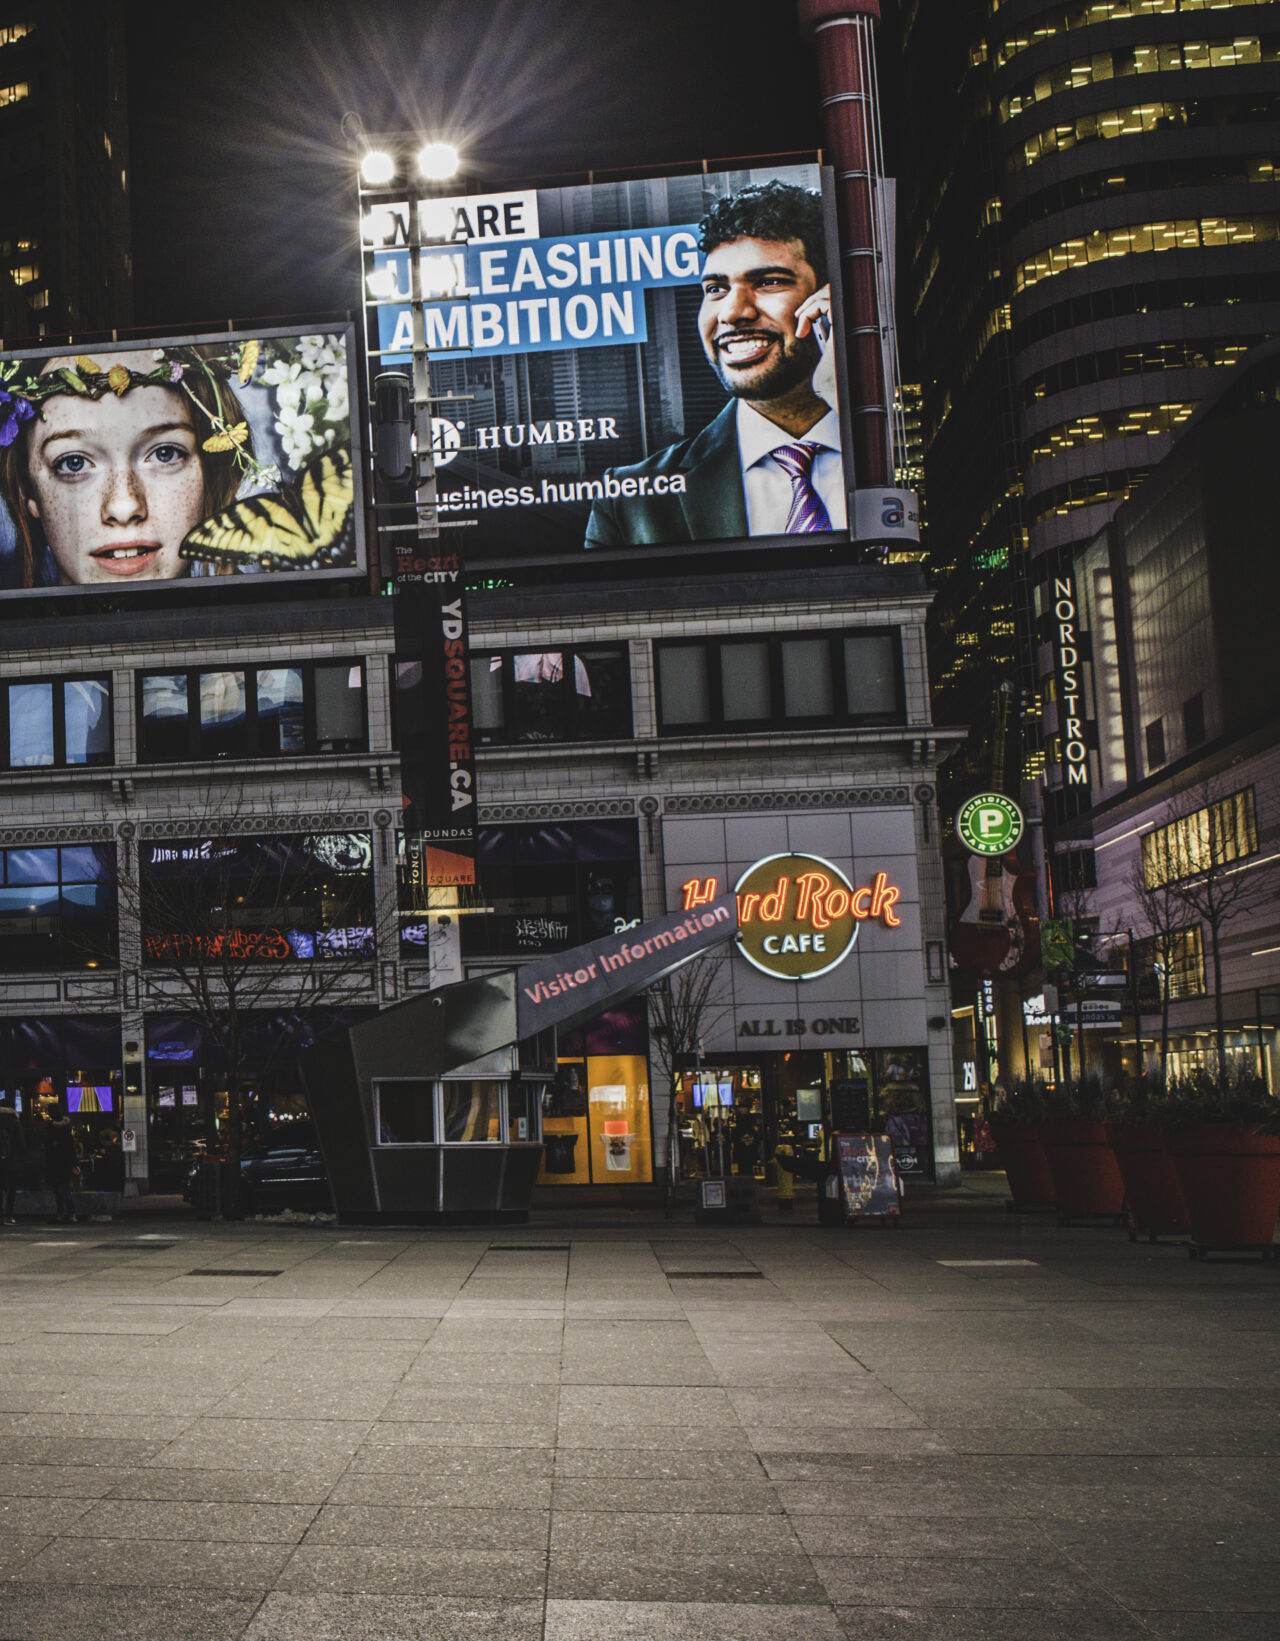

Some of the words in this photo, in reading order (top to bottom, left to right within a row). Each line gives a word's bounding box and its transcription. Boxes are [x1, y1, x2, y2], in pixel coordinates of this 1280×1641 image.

[450, 201, 526, 240] ARE
[386, 232, 701, 300] ULEASHING
[389, 290, 635, 351] AMBITION
[477, 417, 620, 450] HUMBER
[416, 473, 688, 513] usiness.humber.ca
[395, 546, 413, 555] The
[396, 552, 460, 572] Heart
[396, 574, 406, 583] of
[407, 572, 422, 583] the
[423, 570, 460, 583] CITY
[1054, 577, 1088, 785] NORDSTROM
[441, 598, 473, 812] YDSQUARE.CA
[962, 795, 1017, 820] MUNICIPAL
[978, 808, 1005, 833] P
[423, 828, 474, 839] DUNDAS
[962, 826, 1020, 853] PARKING
[430, 874, 473, 884] SQUARE
[796, 871, 902, 929] Rock
[523, 962, 597, 1005] Visitor
[599, 906, 731, 974] Information
[763, 933, 827, 955] CAFE
[738, 1019, 782, 1037] ALL
[785, 1018, 807, 1036] IS
[811, 1017, 860, 1035] ONE
